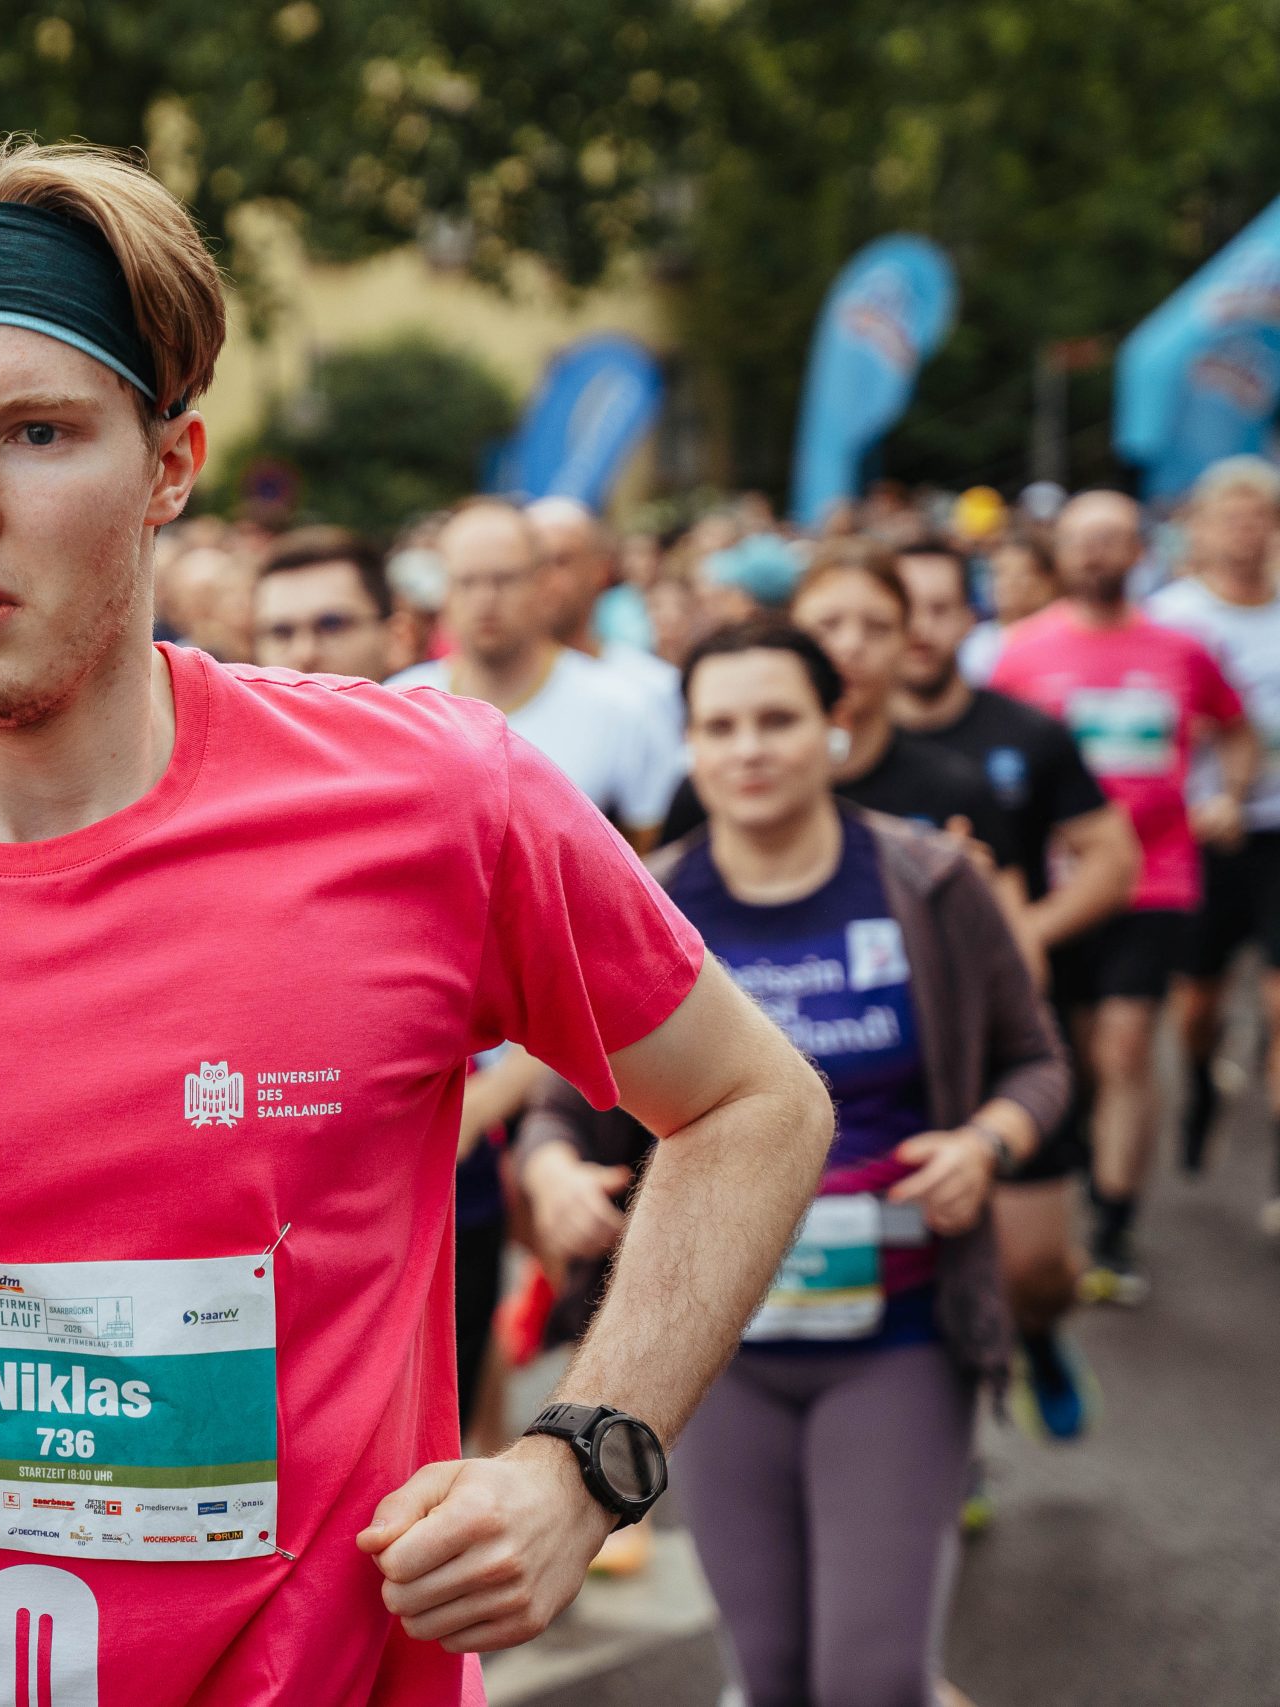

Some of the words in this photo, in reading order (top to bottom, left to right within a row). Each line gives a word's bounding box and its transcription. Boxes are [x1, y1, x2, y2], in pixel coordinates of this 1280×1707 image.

[257, 1068, 341, 1084] UNIVERSITÄT
[257, 1089, 283, 1101] DES
[257, 1103, 342, 1117] SAARLANDES
[0, 1298, 40, 1312] FIRMEN
[49, 1305, 94, 1315] SAARBRÜCKEN
[0, 1311, 41, 1329] LAUF
[36, 1427, 95, 1459] 736
[19, 1466, 66, 1480] STARTZEIT
[67, 1469, 92, 1481] 18:00
[93, 1470, 113, 1482] UHR
[18, 1528, 60, 1538] DECATHLON
[143, 1535, 198, 1543] WOCHENSPIEGEL
[207, 1531, 243, 1541] FORUM
